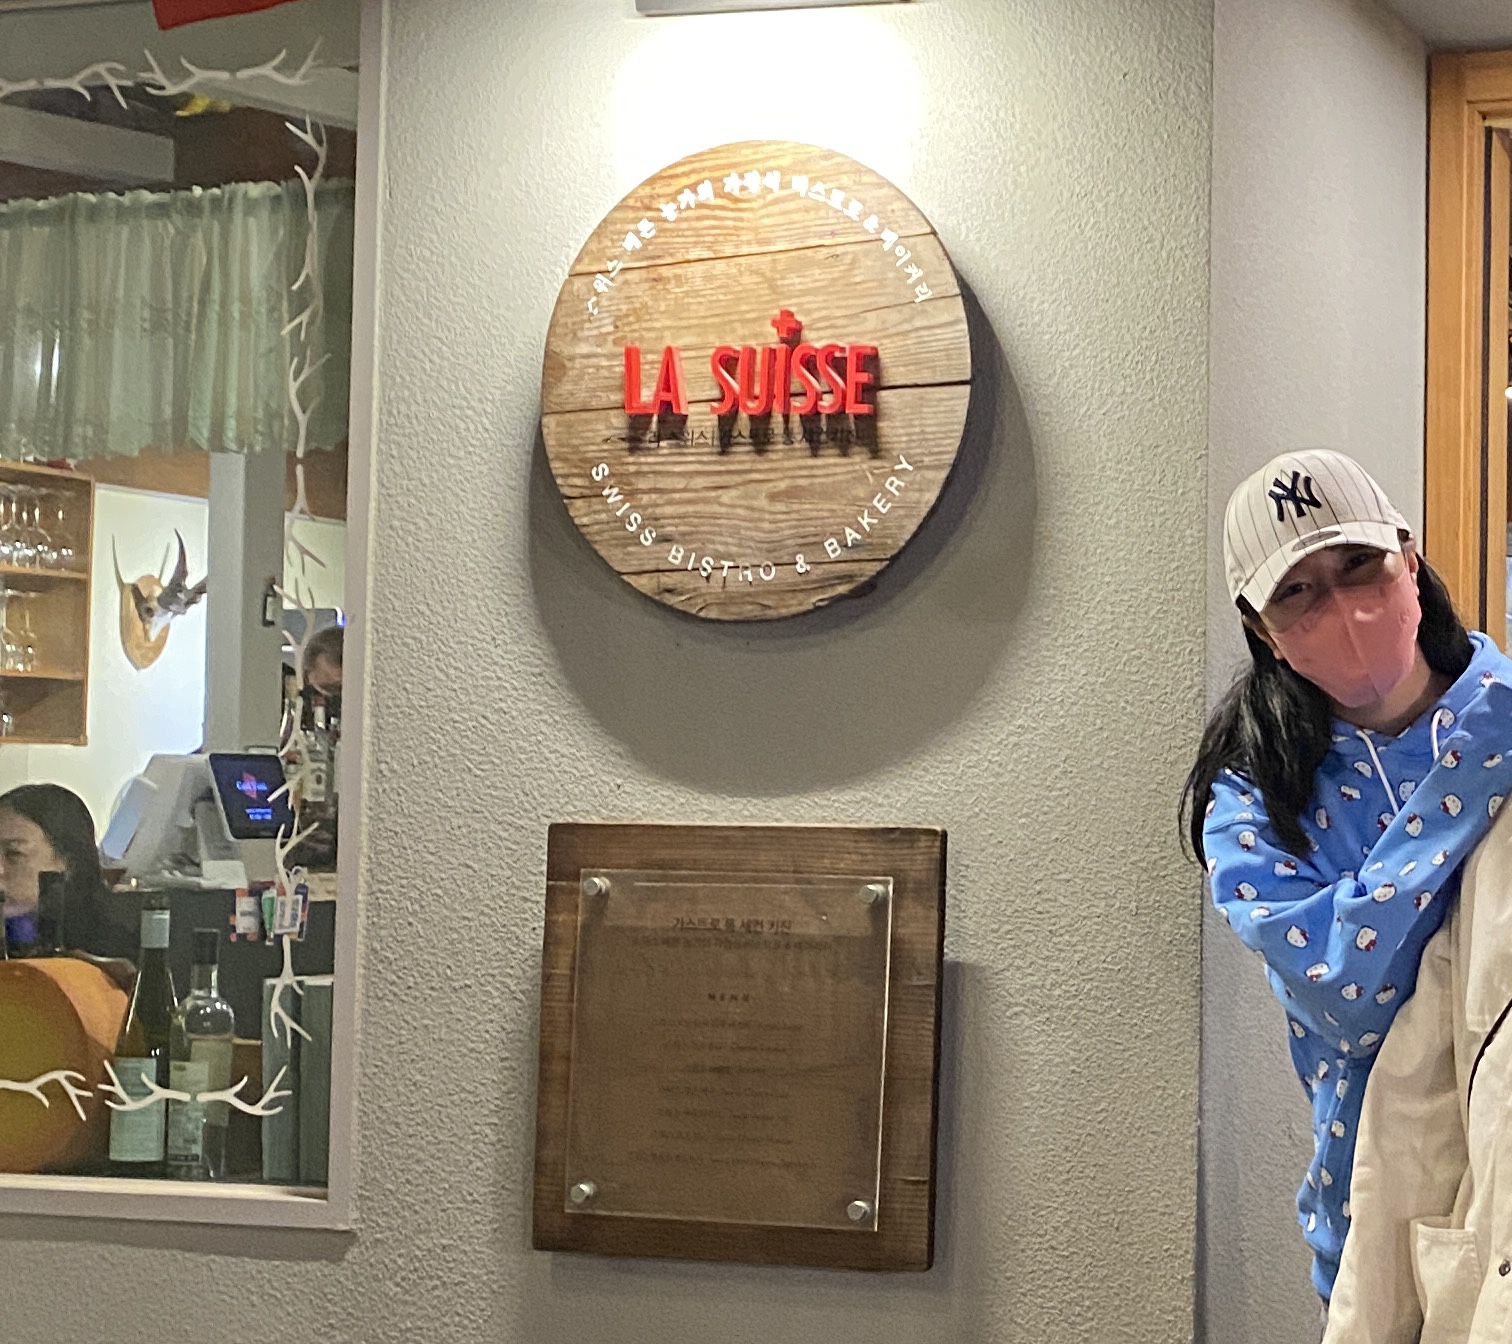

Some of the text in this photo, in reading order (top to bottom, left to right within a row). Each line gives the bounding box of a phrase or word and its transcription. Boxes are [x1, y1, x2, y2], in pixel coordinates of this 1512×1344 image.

[624, 343, 876, 416] LA SUISSE
[591, 455, 914, 582] SWISS BISTRO & BAKERY
[1269, 471, 1322, 522] NY
